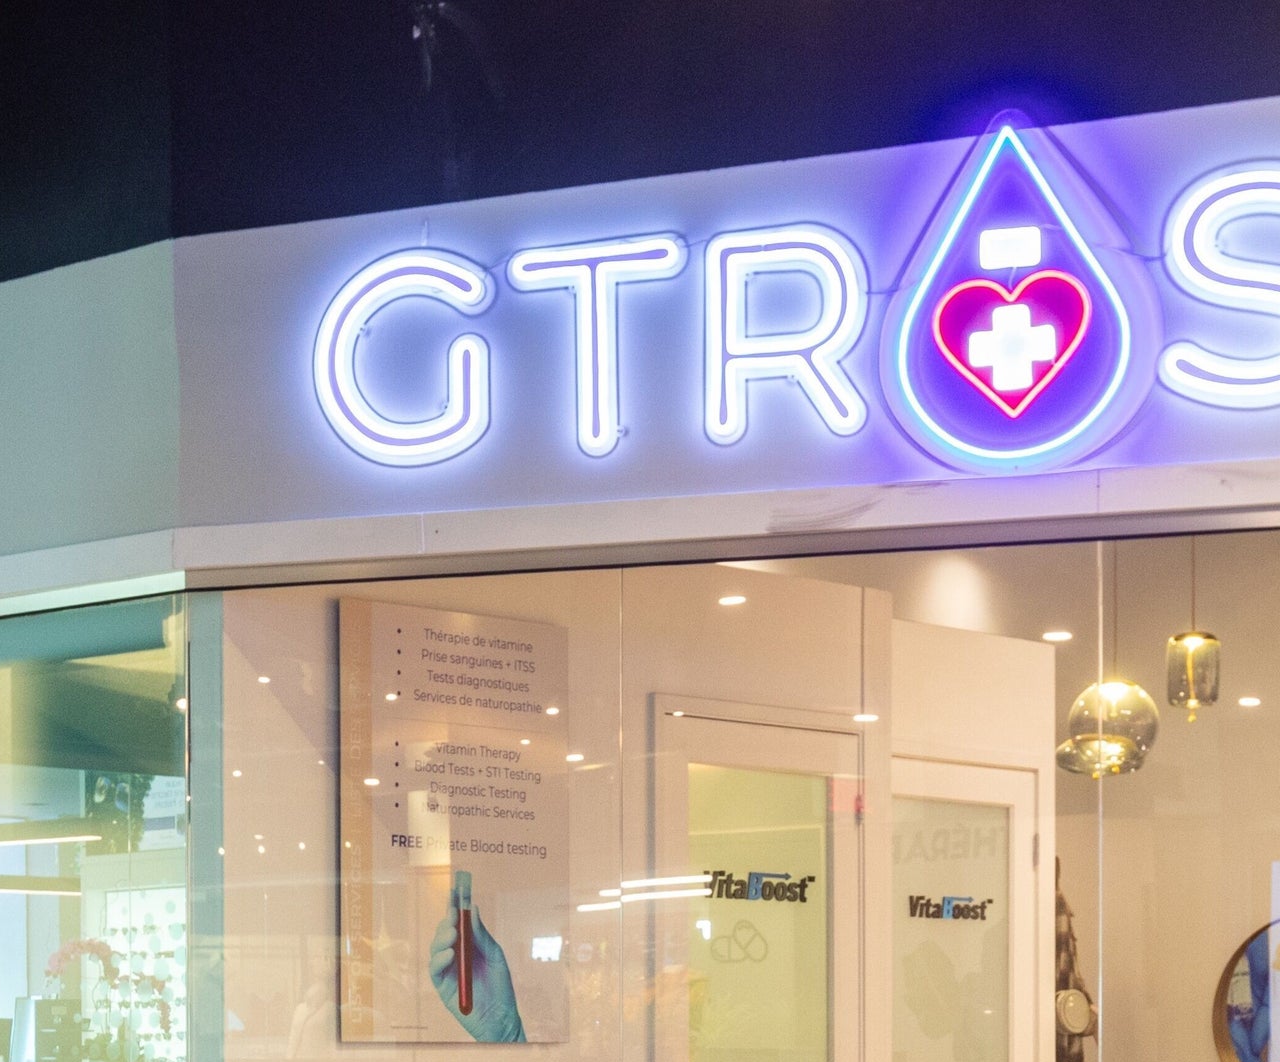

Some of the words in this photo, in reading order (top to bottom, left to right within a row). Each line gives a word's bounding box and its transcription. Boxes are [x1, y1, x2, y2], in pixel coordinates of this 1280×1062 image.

[313, 222, 870, 468] GTR
[423, 628, 470, 646] Thérapie
[472, 635, 486, 647] de
[489, 637, 533, 653] vitamine
[421, 648, 447, 663] Prise
[450, 654, 503, 670] sanguines
[514, 659, 536, 673] ITSS
[426, 669, 454, 684] Tests
[457, 674, 530, 692] diagnostiques
[413, 688, 457, 704] Services
[459, 694, 472, 706] de
[475, 699, 542, 714] naturopathie
[435, 742, 477, 757] Vitamin
[479, 745, 521, 763] Therapy
[414, 759, 445, 774] Blood
[448, 762, 475, 777] Tests
[485, 766, 501, 778] STI
[504, 768, 541, 784] Testing
[430, 781, 486, 797] Diagnostic
[489, 785, 527, 803] Testing
[493, 806, 535, 820] Services
[391, 834, 422, 849] FREE
[470, 839, 504, 854] Blood
[507, 843, 547, 859] testing
